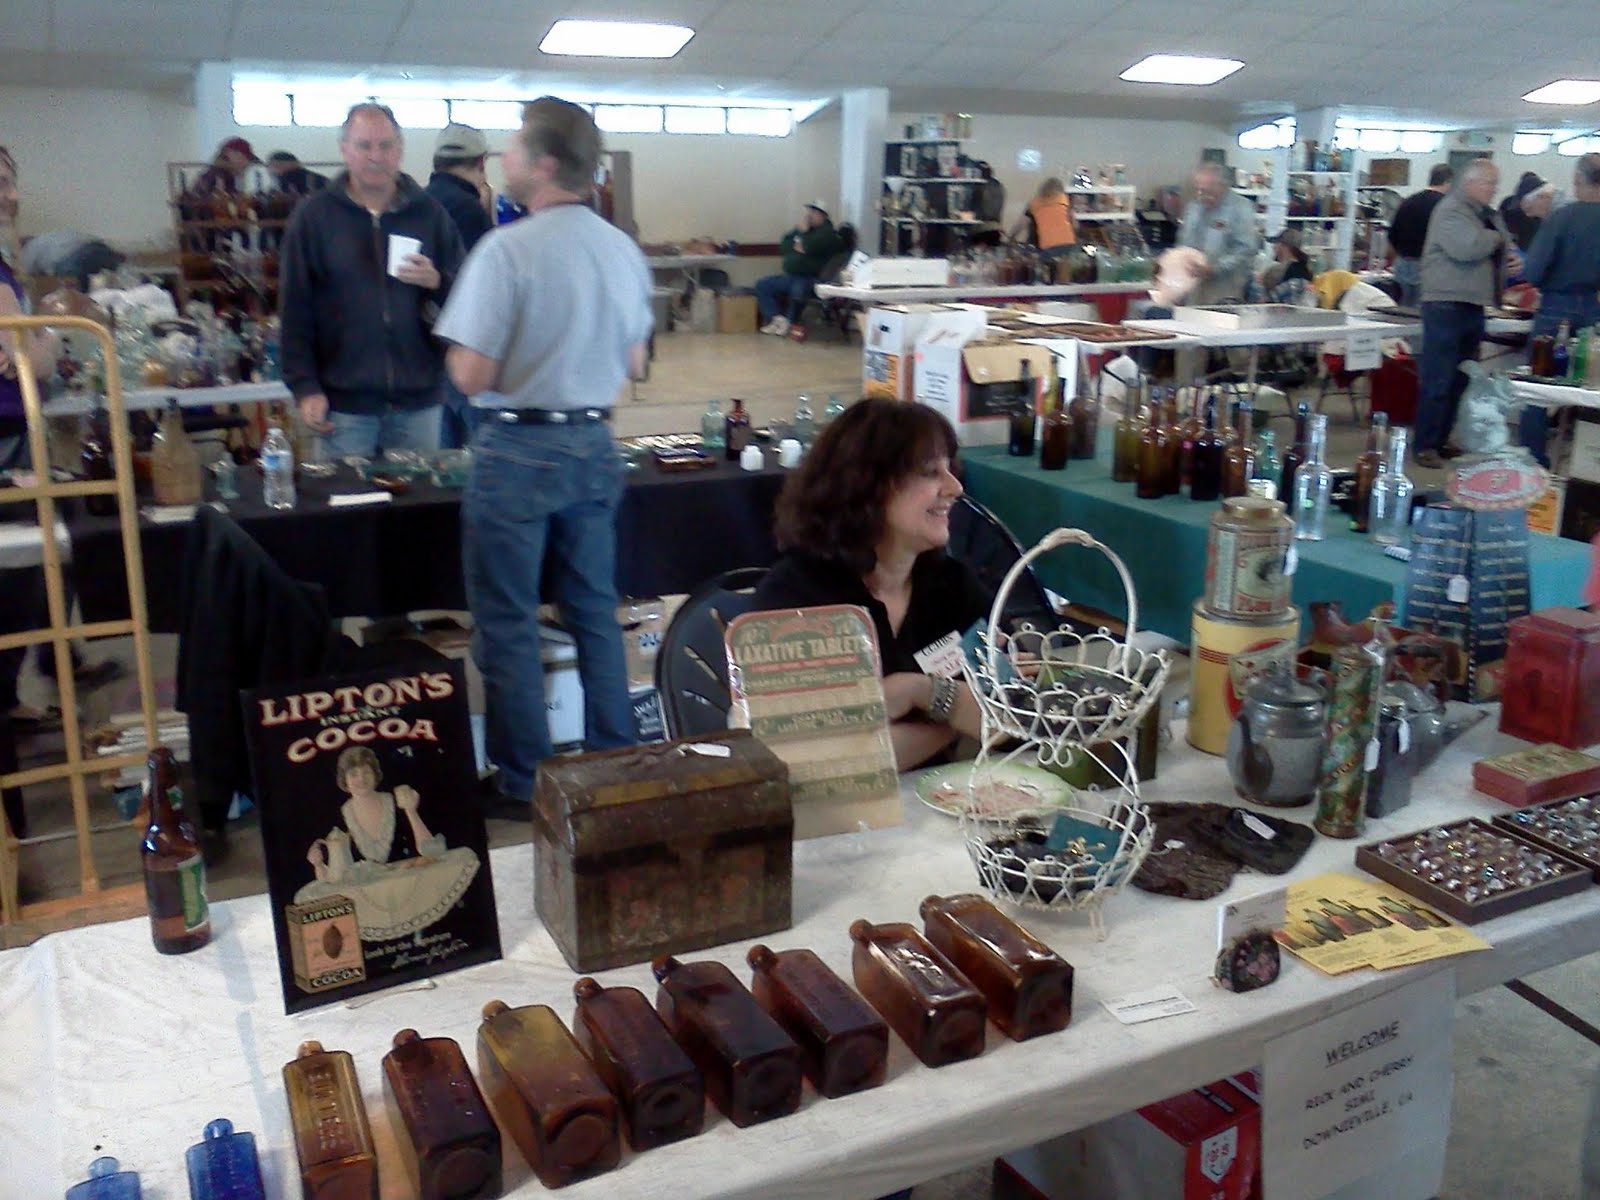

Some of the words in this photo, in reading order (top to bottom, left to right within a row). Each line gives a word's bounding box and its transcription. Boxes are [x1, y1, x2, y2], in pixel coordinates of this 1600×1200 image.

[258, 671, 455, 727] LIPTON'S
[286, 717, 439, 764] COCOA
[312, 968, 362, 987] COCOA
[1325, 1020, 1400, 1067] WELCOME
